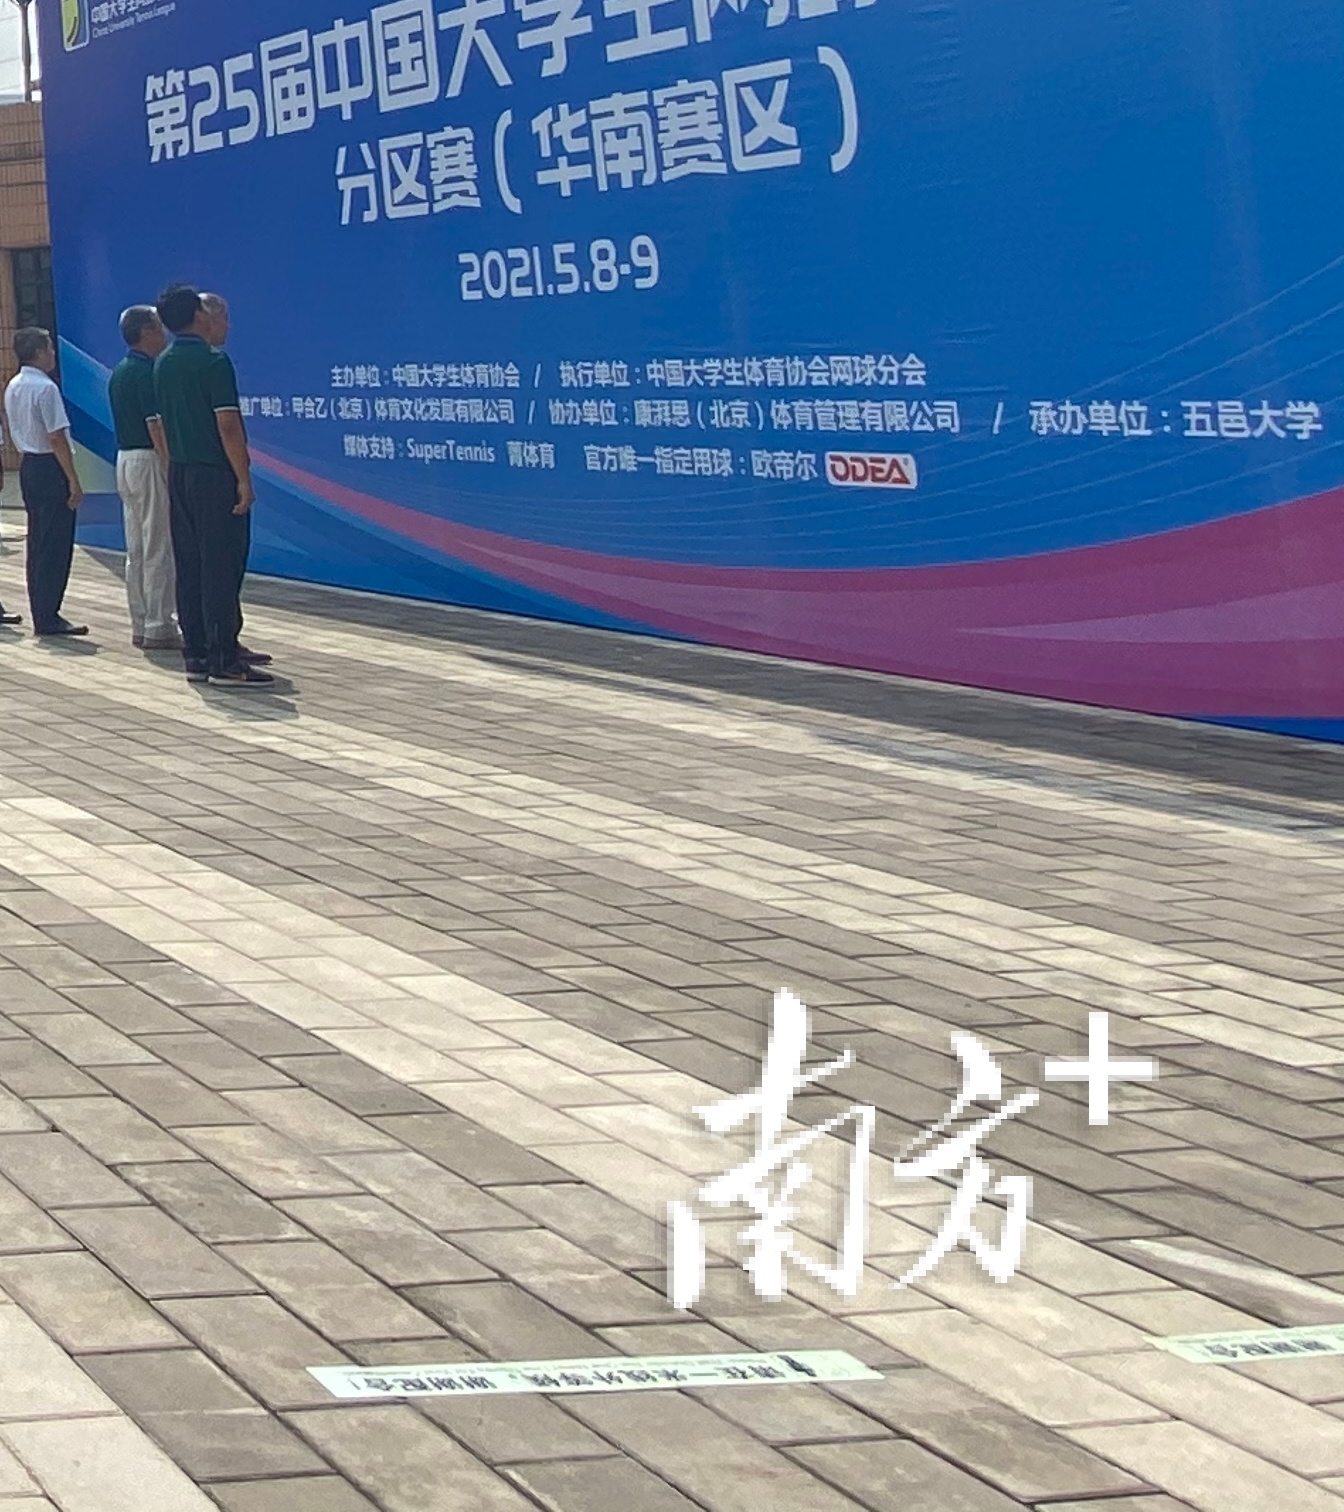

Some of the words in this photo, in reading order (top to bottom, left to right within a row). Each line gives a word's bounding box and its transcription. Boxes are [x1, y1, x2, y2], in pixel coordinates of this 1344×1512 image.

[334, 45, 859, 226] 分区赛（华南赛区）
[331, 362, 520, 388] 主办单位：中国大学生体育协会
[560, 354, 927, 388] 执行单位：中国大学生体育协会网球分会
[1028, 400, 1324, 441] 承办单位：五邑大学
[583, 444, 818, 482] 官方唯一指定用球：欧帝尔
[829, 454, 912, 485] ODEA
